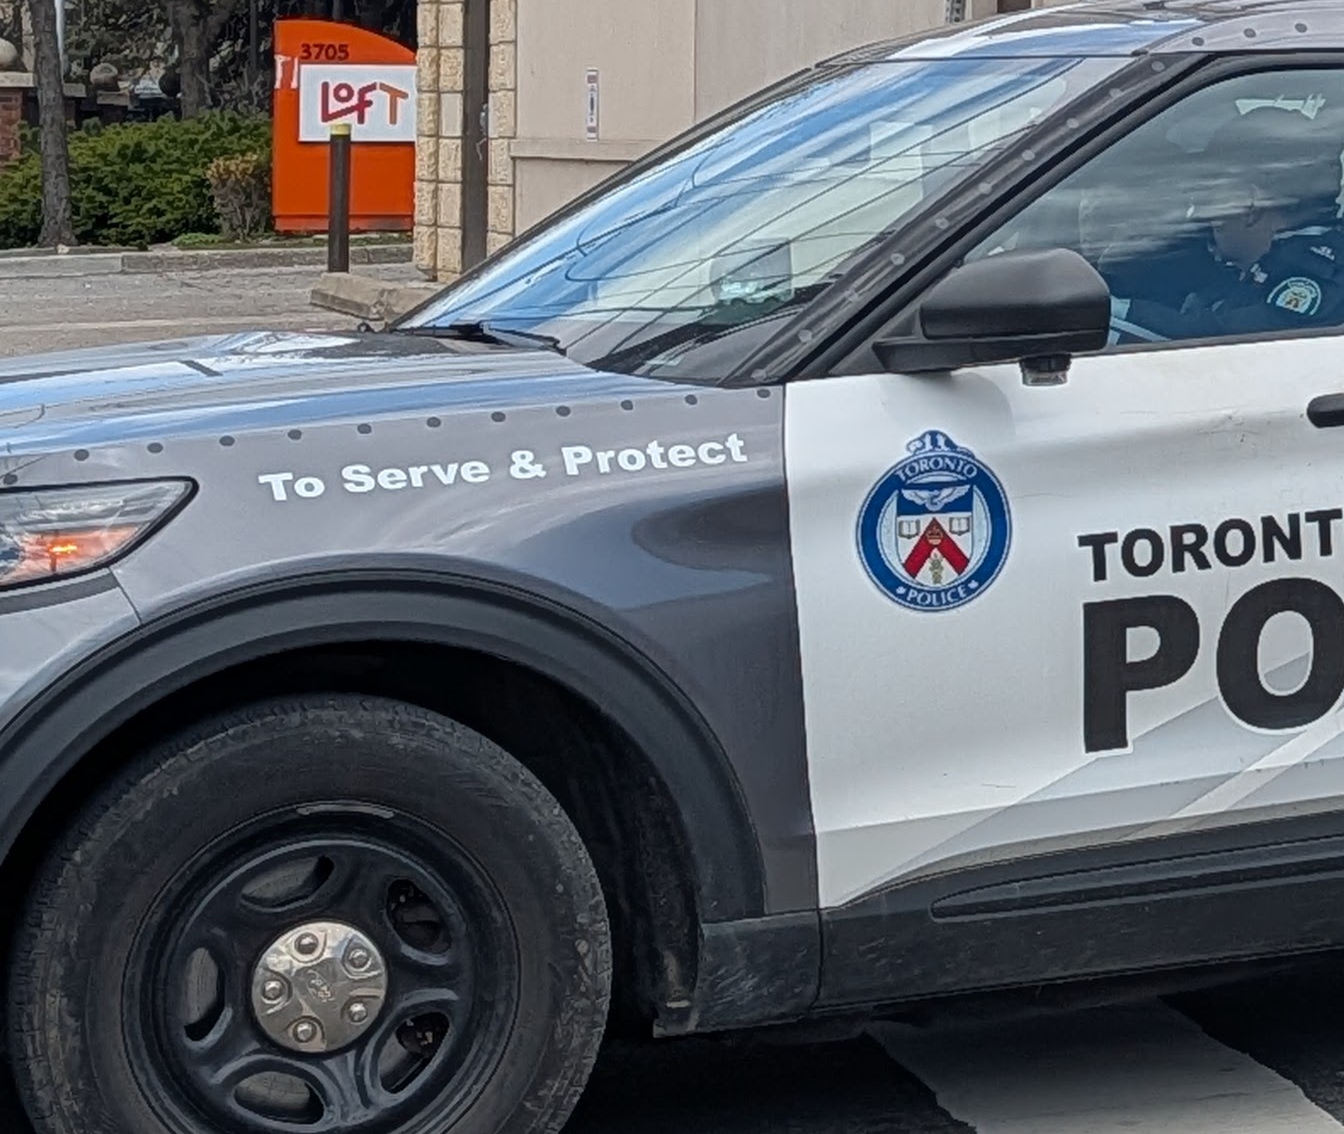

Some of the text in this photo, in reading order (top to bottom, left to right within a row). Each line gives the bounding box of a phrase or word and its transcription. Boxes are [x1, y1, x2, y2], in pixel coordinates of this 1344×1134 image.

[300, 43, 350, 61] 3705
[257, 432, 749, 502] To Serve & Protect
[895, 456, 978, 482] TORONTO
[906, 584, 967, 607] POLICE
